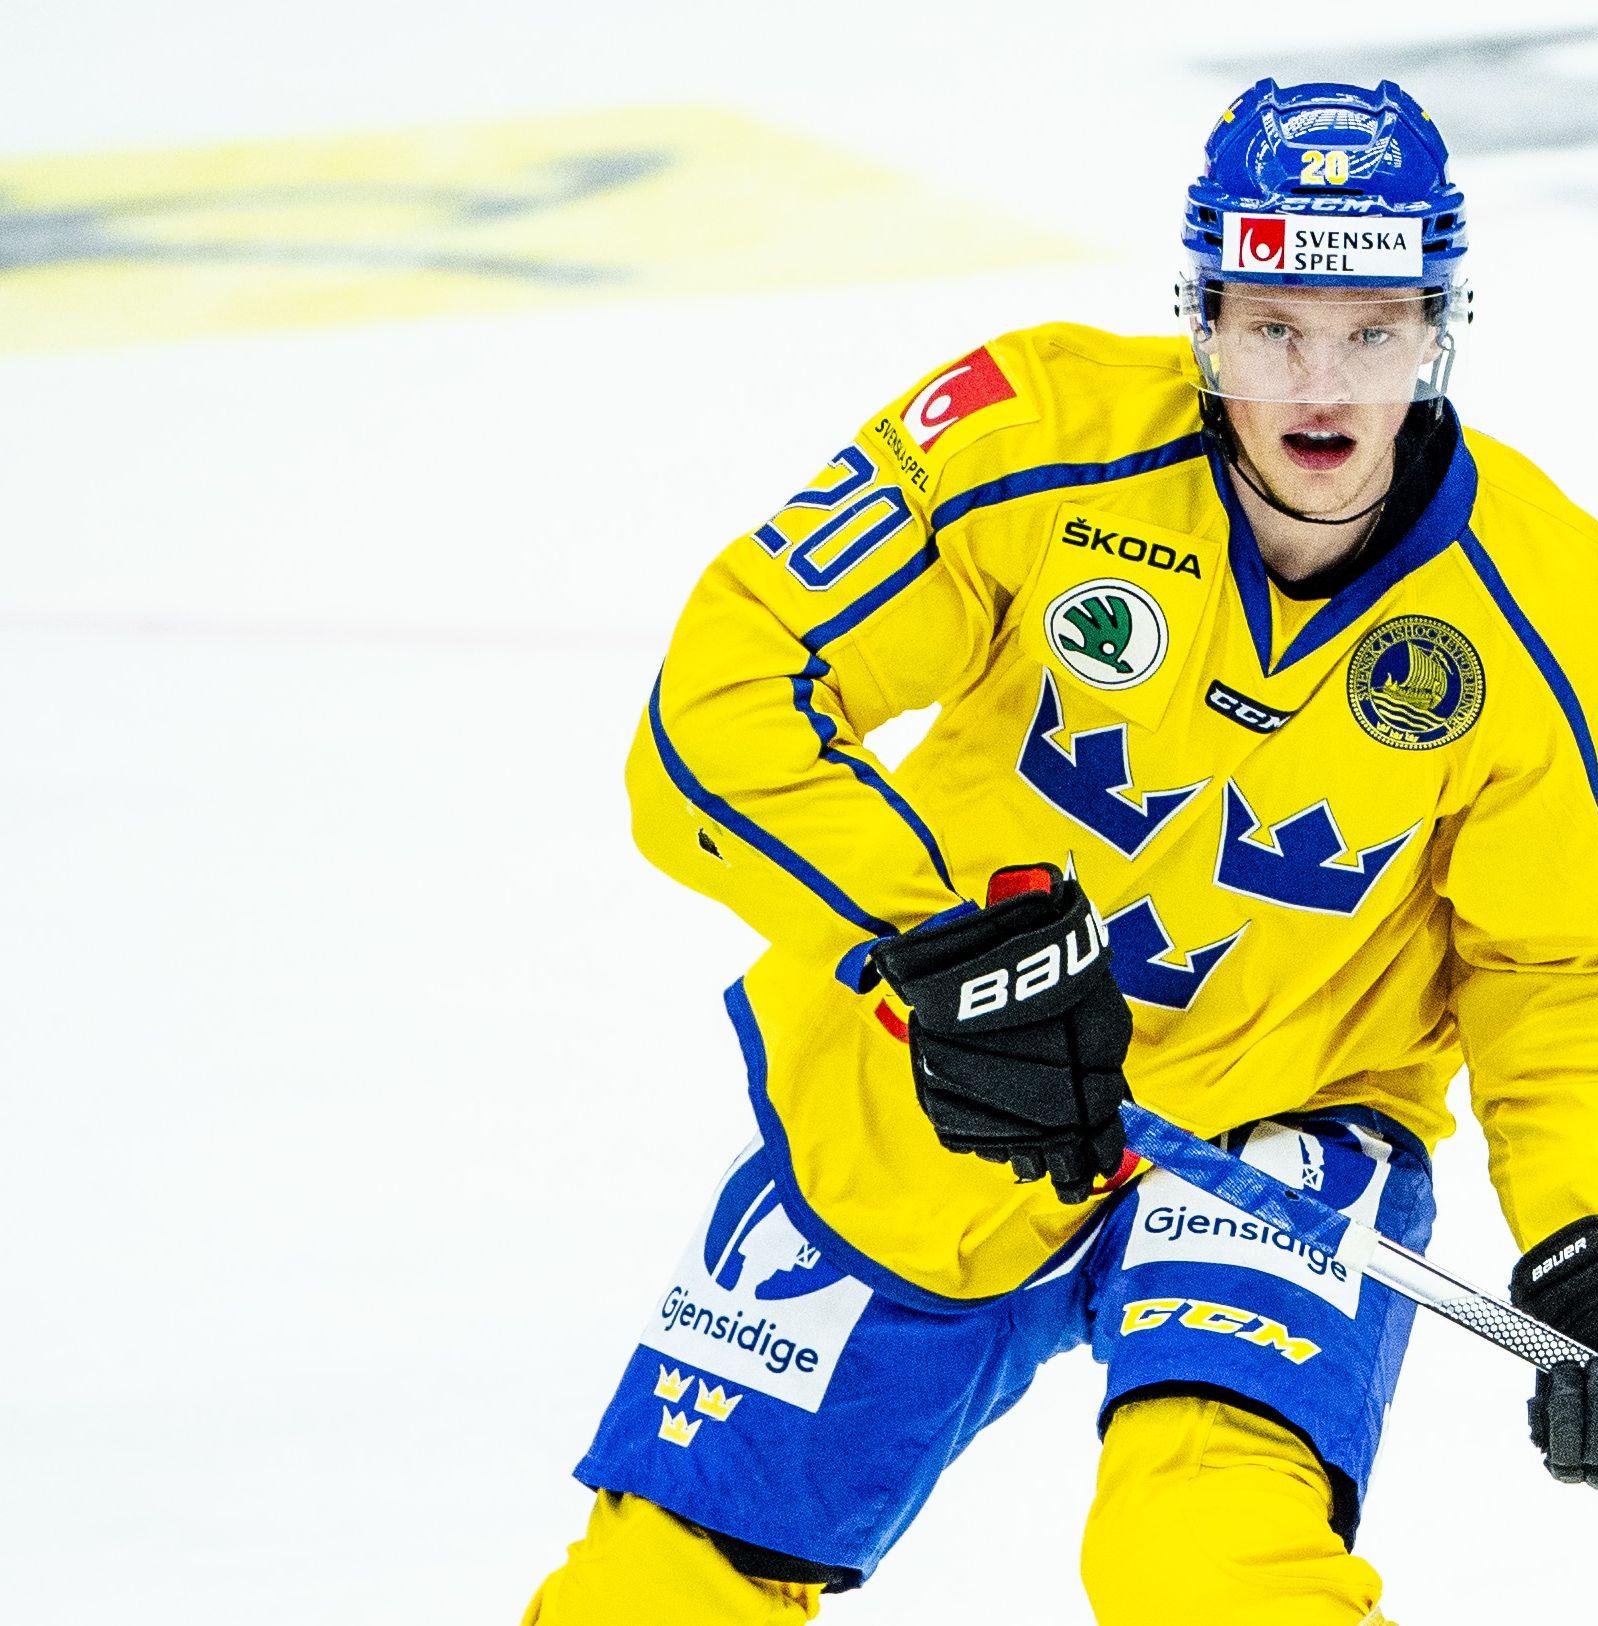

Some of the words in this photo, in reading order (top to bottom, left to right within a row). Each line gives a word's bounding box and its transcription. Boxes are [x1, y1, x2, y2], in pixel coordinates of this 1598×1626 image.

[1300, 150, 1349, 185] 20
[1280, 197, 1376, 212] CCM
[1294, 230, 1408, 251] SVENSKA
[1294, 252, 1355, 273] SPEL
[901, 456, 930, 494] SPEL
[750, 441, 914, 591] 20
[1061, 516, 1202, 580] ŠKODA
[1145, 1206, 1347, 1282] Gjensidige
[661, 1286, 819, 1374] Gjensidige
[1120, 1298, 1322, 1364] CCM
